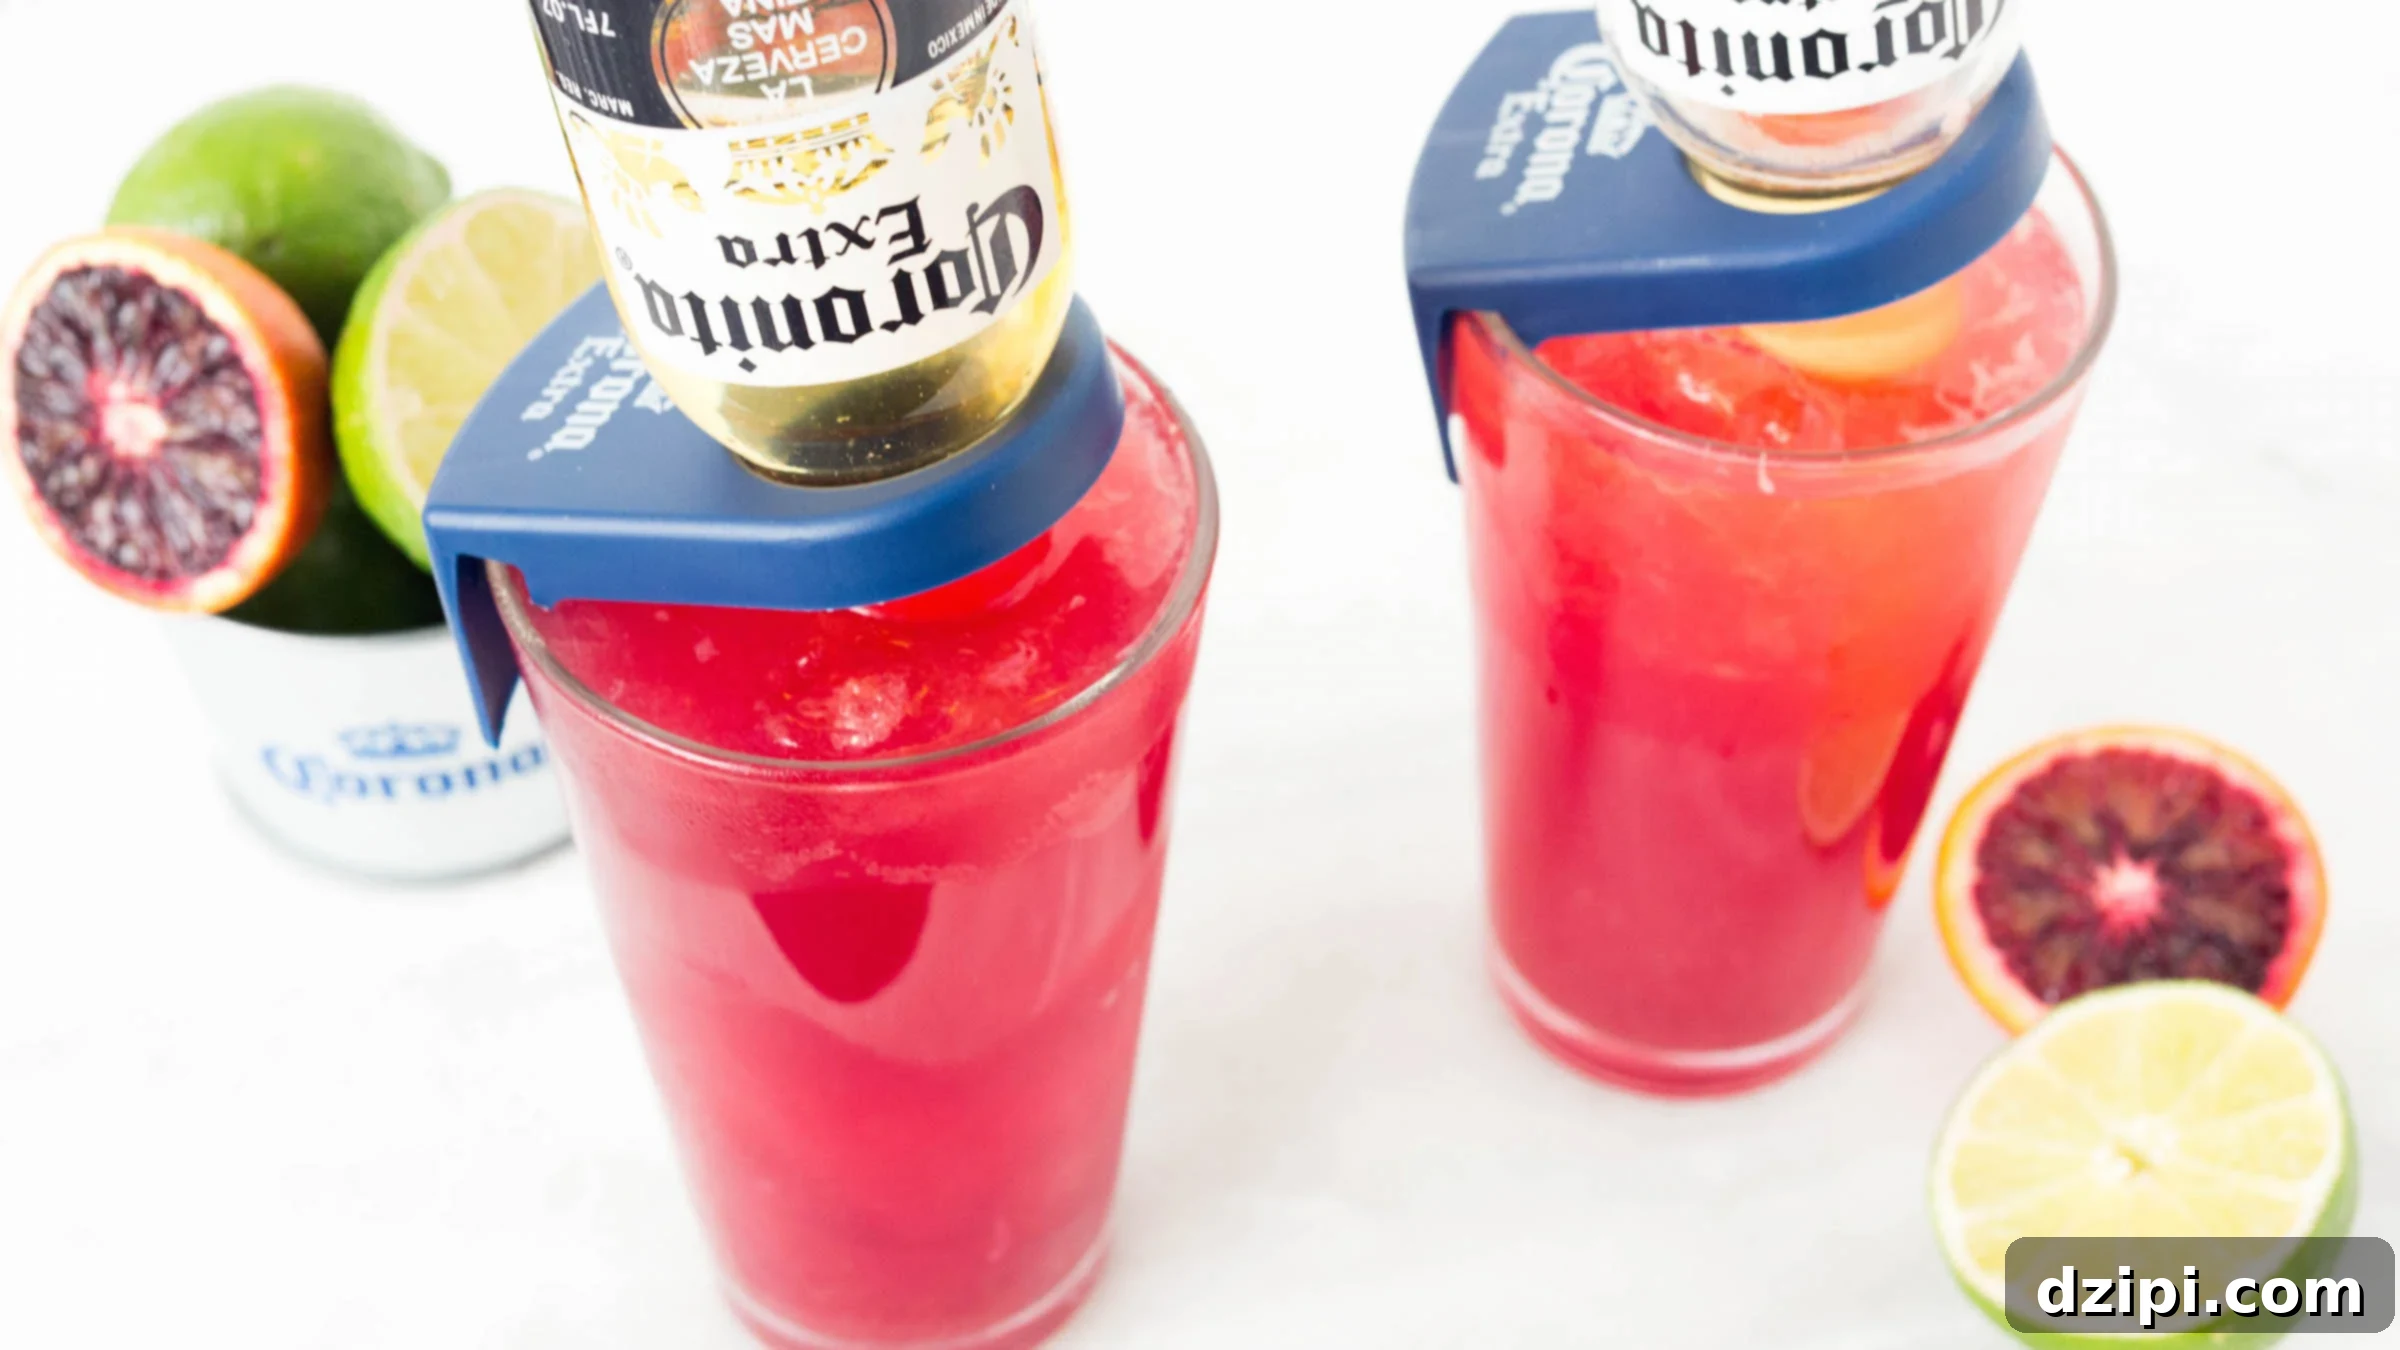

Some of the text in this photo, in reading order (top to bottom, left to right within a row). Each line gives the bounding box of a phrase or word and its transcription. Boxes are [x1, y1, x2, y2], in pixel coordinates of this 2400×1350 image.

[688, 26, 867, 86] CERVEZA
[727, 6, 814, 50] MAS
[760, 75, 814, 108] LA
[1513, 42, 1618, 205] Corona
[1475, 91, 1548, 180] Extra
[716, 195, 932, 269] Extra
[634, 183, 1044, 373] Coronita
[521, 335, 625, 422] Extra
[260, 745, 547, 805] Corona
